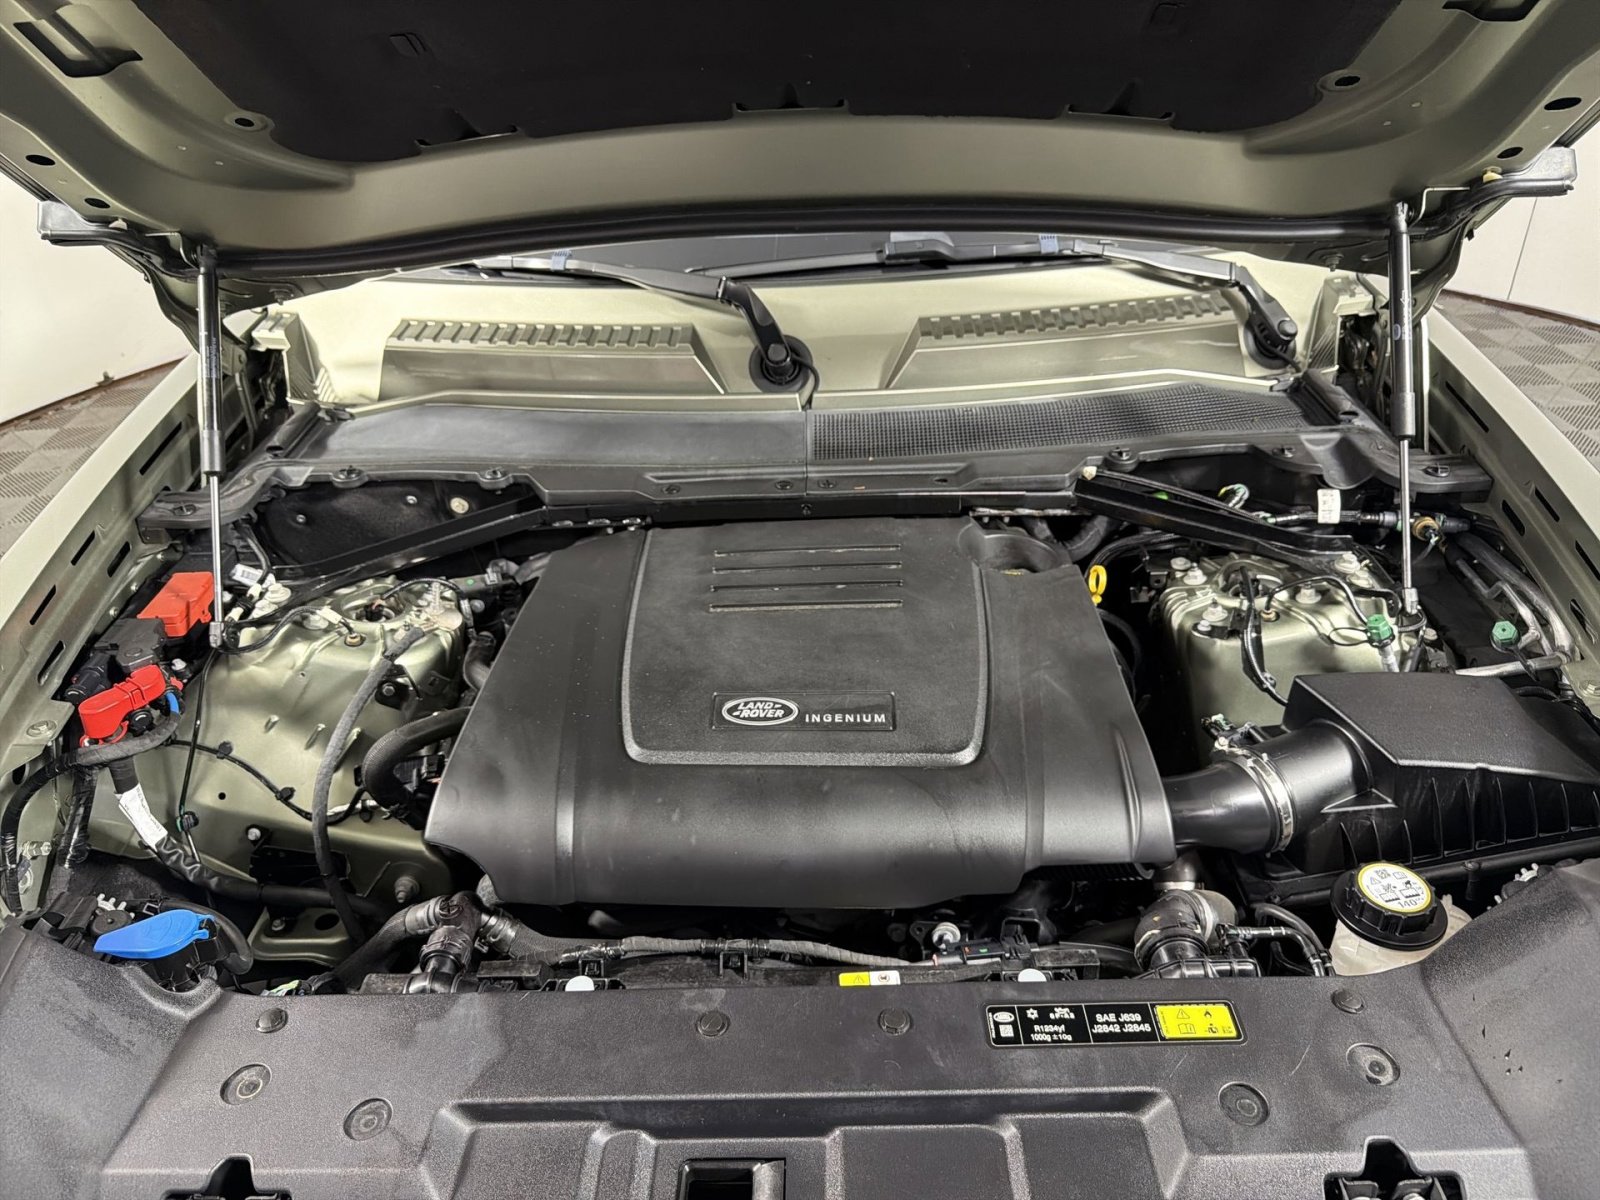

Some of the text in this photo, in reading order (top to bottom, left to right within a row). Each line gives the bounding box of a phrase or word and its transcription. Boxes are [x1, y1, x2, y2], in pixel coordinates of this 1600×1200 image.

[737, 702, 774, 710] LAND
[739, 709, 785, 718] ROVER
[805, 713, 886, 723] INGENIUM
[1095, 1013, 1142, 1022] SAE J639
